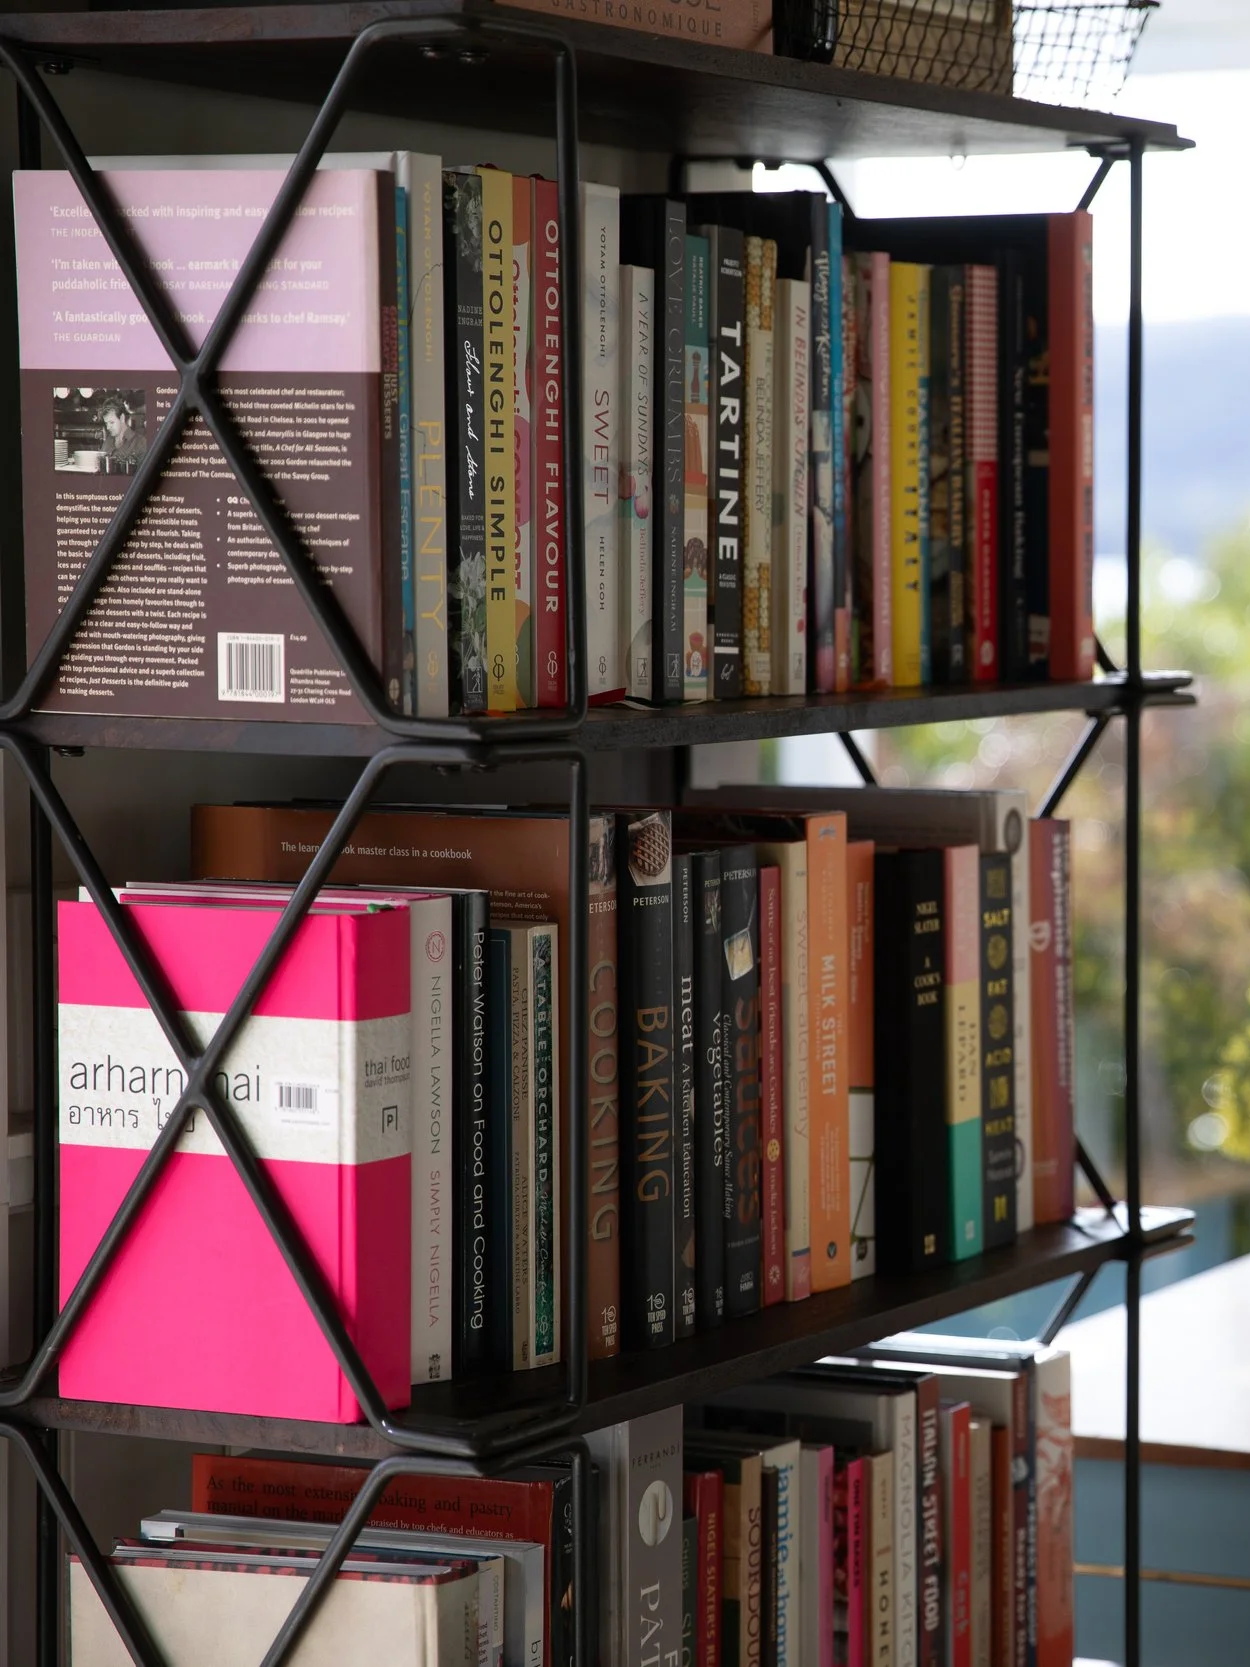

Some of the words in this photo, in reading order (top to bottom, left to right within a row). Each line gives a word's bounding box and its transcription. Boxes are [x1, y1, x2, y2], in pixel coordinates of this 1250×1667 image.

[51, 228, 68, 237] THE
[152, 205, 174, 217] with
[176, 205, 221, 220] inspiring
[222, 205, 242, 217] and
[423, 182, 432, 240] YOTAM
[52, 278, 107, 291] puddaholic
[281, 280, 330, 290] STANDARD
[72, 259, 101, 271] taken
[188, 258, 229, 271] earmark
[283, 258, 298, 270] for
[299, 259, 323, 273] your
[668, 216, 684, 315] LOVE
[65, 311, 127, 325] fantastically
[283, 311, 305, 324] chef
[424, 247, 434, 363] OTTOLENGHI
[457, 304, 483, 315] NADINE
[457, 316, 483, 327] INGRAM
[795, 305, 806, 328] IN
[53, 333, 70, 342] THE
[73, 333, 121, 342] GUARDIAN
[389, 305, 399, 373] GORDON
[488, 220, 505, 454] OTTOLENGHI
[544, 220, 559, 442] OTTOLENGHI
[638, 310, 649, 356] YEAR
[156, 386, 178, 395] Gordon
[249, 387, 280, 396] celebrated
[281, 387, 295, 396] chef
[390, 373, 399, 405] JUST
[638, 364, 649, 386] OF
[239, 401, 253, 410] hold
[253, 402, 269, 410] three
[270, 402, 293, 410] coveted
[294, 402, 320, 411] Michelin
[320, 402, 335, 411] stars
[247, 415, 262, 424] Road
[382, 373, 393, 440] DESSERTS
[464, 402, 480, 442] and
[667, 327, 684, 484] CRUMBS
[755, 376, 765, 445] BELINDA
[400, 413, 412, 479] Great
[593, 389, 610, 505] SWEET
[637, 392, 649, 476] SUNDAYS
[719, 320, 741, 561] TARTINE
[75, 493, 108, 502] sumptuous
[292, 472, 310, 482] Savoy
[755, 447, 765, 515] JEFFERY
[793, 437, 806, 518] KITCHEN
[56, 504, 90, 513] demystifies
[418, 419, 446, 633] PLENTY
[400, 489, 411, 581] Escape
[490, 475, 506, 601] SIMPLE
[545, 462, 559, 613] FLAVOUR
[598, 536, 606, 578] HELEN
[638, 526, 647, 573] Belinda
[670, 526, 678, 578] NADINE
[904, 486, 919, 592] ITALY
[227, 562, 249, 571] Superb
[249, 563, 287, 572] photography
[598, 582, 606, 612] GOH
[637, 574, 647, 617] Jeffery
[670, 579, 678, 632] INGRAM
[66, 676, 88, 685] recipes,
[101, 677, 126, 686] Desserts
[144, 679, 171, 687] definitive
[172, 680, 189, 689] guide
[66, 688, 88, 697] making
[88, 689, 115, 697] desserts.
[280, 841, 297, 852] The
[357, 845, 389, 856] master
[388, 846, 410, 857] class
[411, 847, 420, 857] in
[429, 848, 472, 860] cookbook
[633, 894, 669, 906] PETERSON
[767, 888, 776, 929] Some
[915, 900, 938, 916] NIGEL
[983, 908, 1011, 929] SALT
[913, 917, 941, 935] SLATER
[473, 931, 485, 987] Peter
[536, 957, 546, 970] A
[797, 910, 808, 1001] sweet
[768, 967, 777, 997] best
[821, 954, 835, 1010] MILK
[916, 991, 938, 1007] BOOK
[986, 978, 1008, 997] FAT
[430, 975, 442, 1059] NIGELLA
[473, 993, 485, 1076] Watson
[512, 1011, 520, 1046] PIZZA
[537, 979, 547, 1052] TABLE
[681, 974, 694, 1054] meat
[723, 1013, 732, 1058] Classical
[768, 1001, 777, 1050] friends
[364, 1055, 389, 1078] thai
[390, 1054, 411, 1074] food
[521, 1036, 529, 1101] PANISSE
[682, 1062, 691, 1074] A
[723, 1059, 733, 1079] and
[795, 1014, 810, 1140] alchemy
[821, 1017, 837, 1096] STREET
[985, 1047, 1013, 1068] ACID
[363, 1075, 383, 1089] david
[473, 1083, 483, 1112] on
[512, 1065, 520, 1122] CALZONE
[589, 959, 619, 1241] COOKING
[636, 1005, 670, 1202] BAKING
[706, 1008, 723, 1167] vegetables
[768, 1075, 778, 1135] Cookies
[68, 1104, 140, 1129] อาหาร
[430, 1065, 441, 1155] LAWSON
[537, 1067, 548, 1182] ORCHARD
[682, 1078, 692, 1137] Kitchen
[722, 1080, 733, 1149] Contemporary
[984, 1117, 1014, 1137] HEAT
[473, 1119, 485, 1177] Food
[723, 1149, 733, 1179] Sauce
[429, 1170, 441, 1236] SIMPLY
[521, 1175, 529, 1218] ALICE
[682, 1142, 692, 1219] Education
[722, 1180, 734, 1220] Making
[473, 1184, 485, 1229] and
[521, 1224, 529, 1286] WATERS
[429, 1245, 440, 1328] NIGELLA
[470, 1235, 485, 1330] Cooking
[922, 1409, 938, 1487] ITALIAN
[206, 1475, 225, 1490] As
[232, 1477, 255, 1493] the
[262, 1480, 297, 1497] most
[434, 1497, 461, 1513] and
[469, 1500, 513, 1520] pastry
[207, 1501, 258, 1516] manual
[285, 1502, 308, 1520] the
[899, 1414, 912, 1584] MAGNOLIA
[426, 1523, 447, 1534] chefs
[465, 1526, 504, 1539] educators
[707, 1512, 717, 1562] NIGEL
[922, 1495, 938, 1567] STREET
[924, 1574, 939, 1632] FOOD
